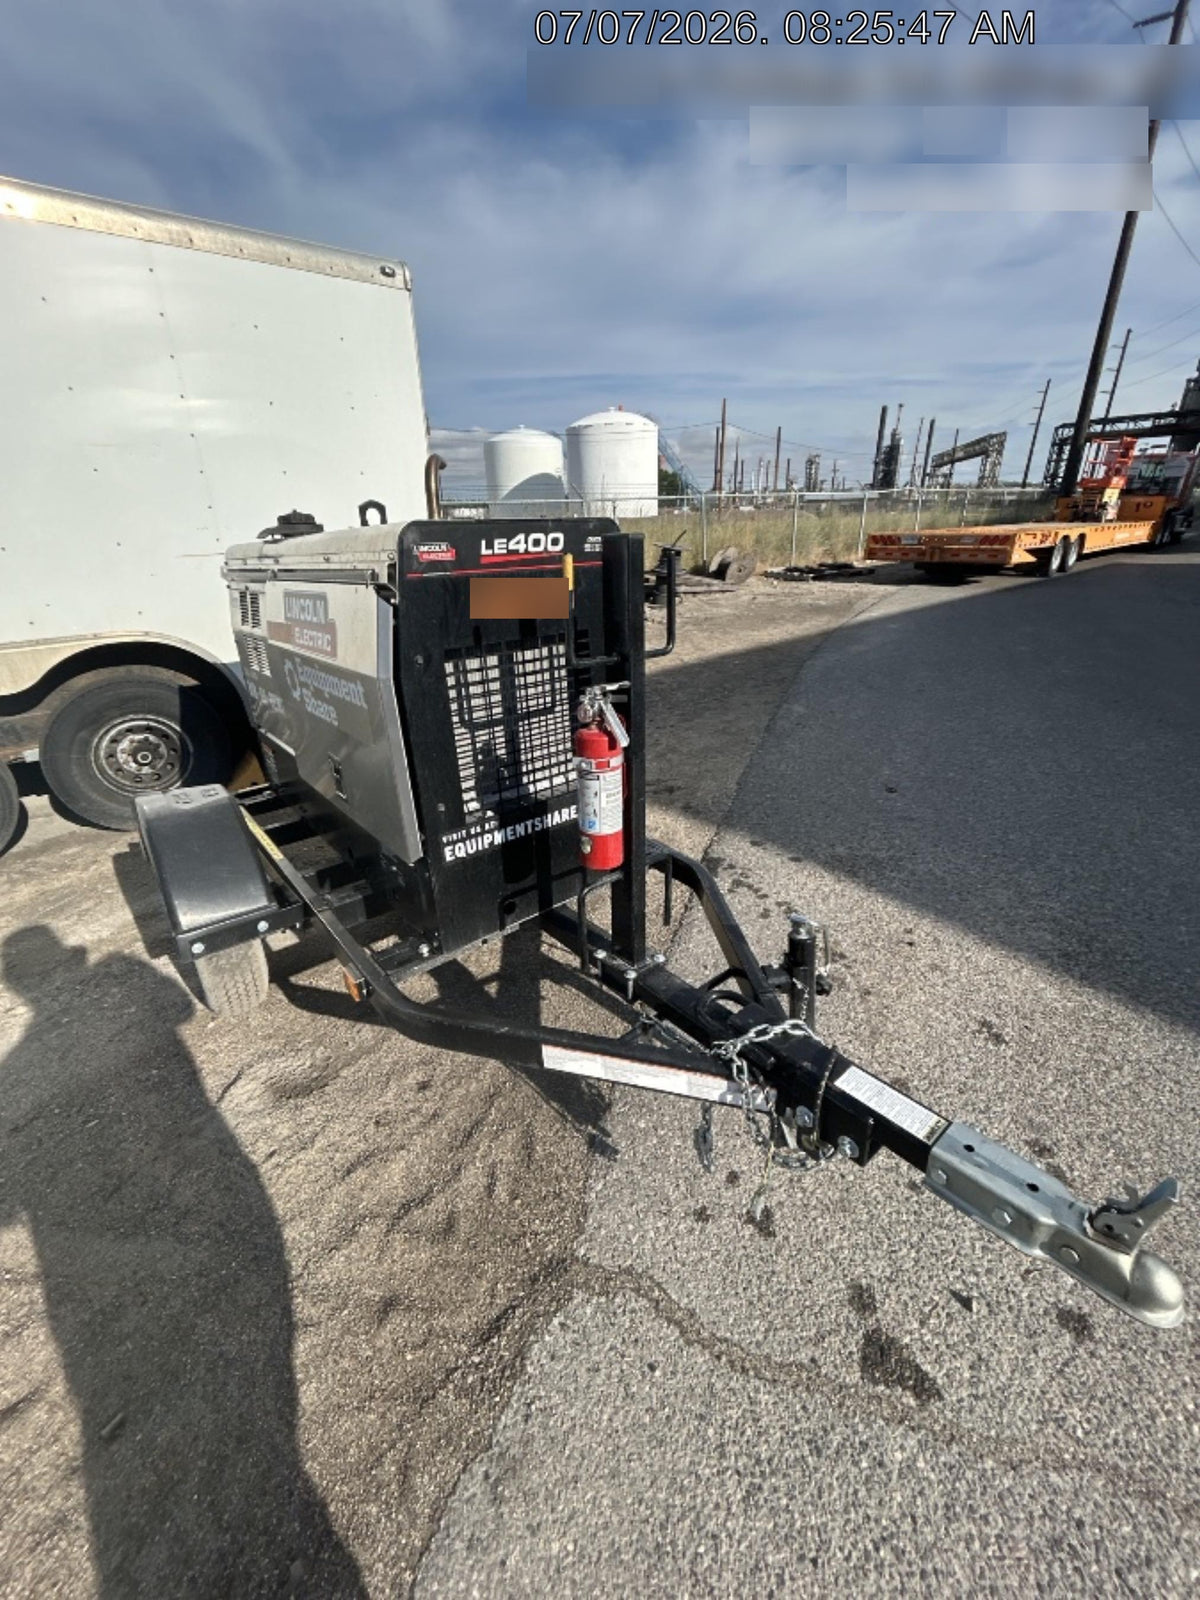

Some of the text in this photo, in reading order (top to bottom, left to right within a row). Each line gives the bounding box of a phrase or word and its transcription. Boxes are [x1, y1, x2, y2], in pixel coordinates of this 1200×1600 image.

[480, 532, 564, 555] LE400
[284, 596, 327, 625] LINCOLN
[293, 626, 332, 652] ELECTRIC
[444, 804, 579, 862] EQUIPMENTSHARE
